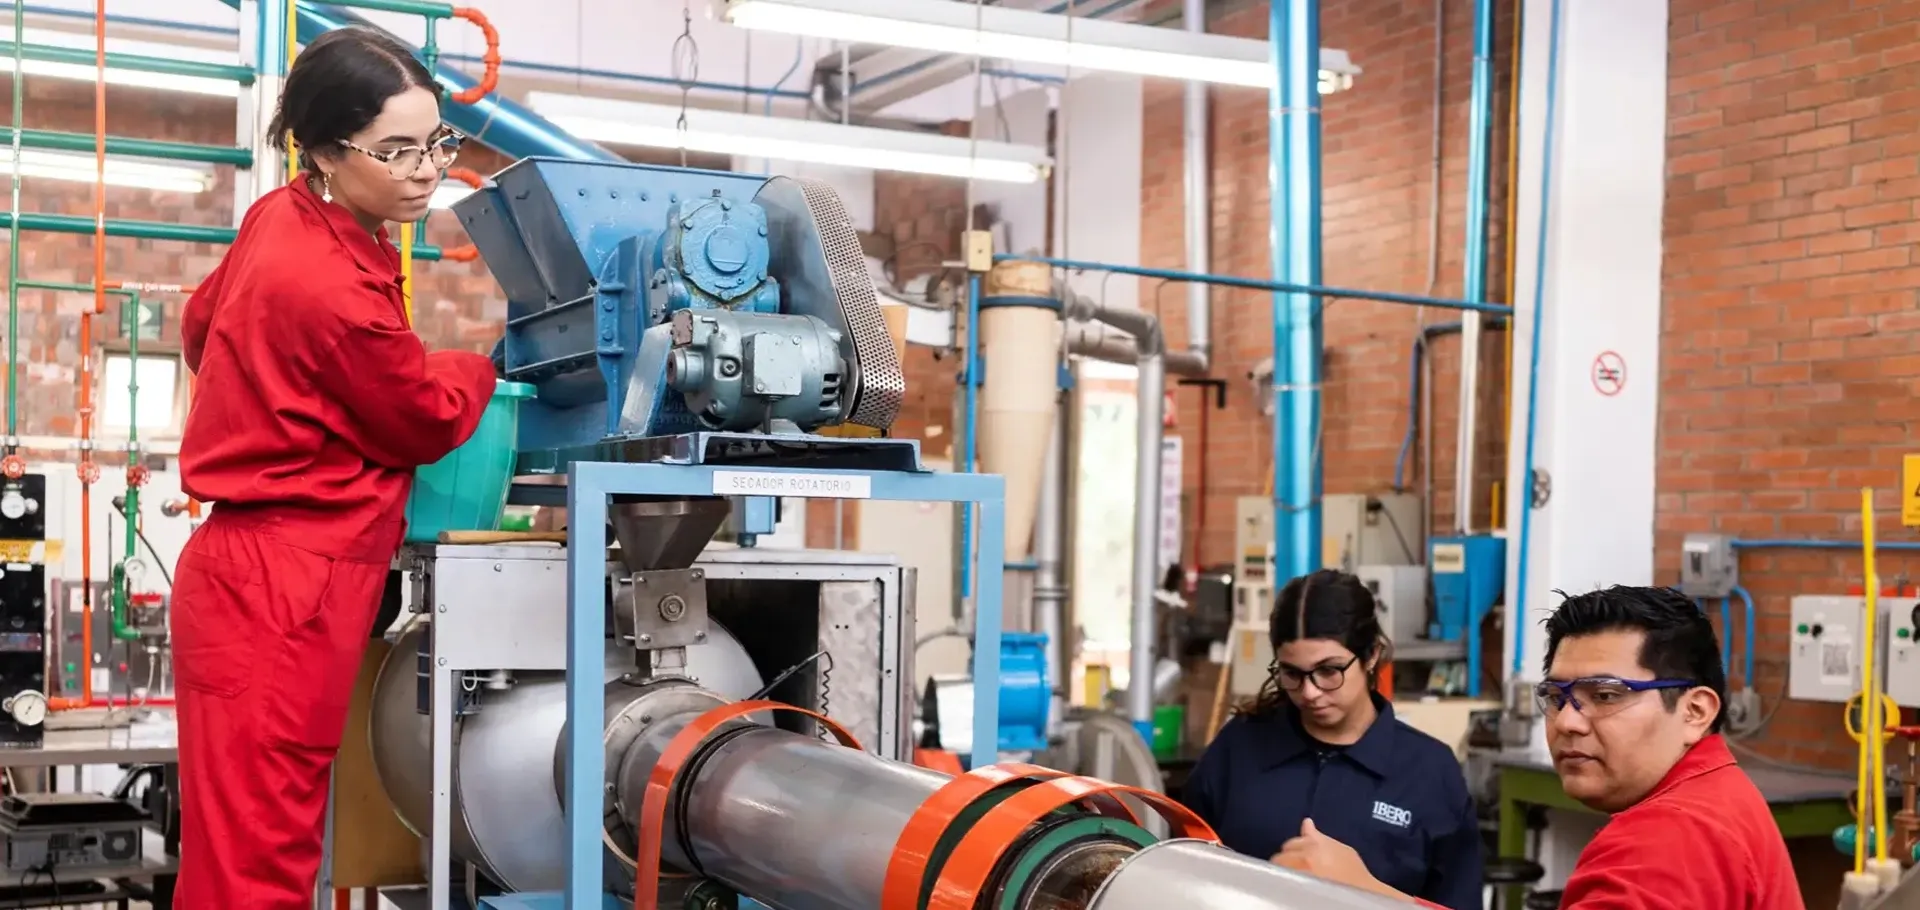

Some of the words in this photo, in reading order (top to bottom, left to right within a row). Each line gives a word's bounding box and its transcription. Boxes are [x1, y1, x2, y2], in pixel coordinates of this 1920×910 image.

[732, 476, 784, 490] SECADOR
[790, 478, 851, 492] ROTATORIO
[1372, 800, 1412, 825] IBERO
